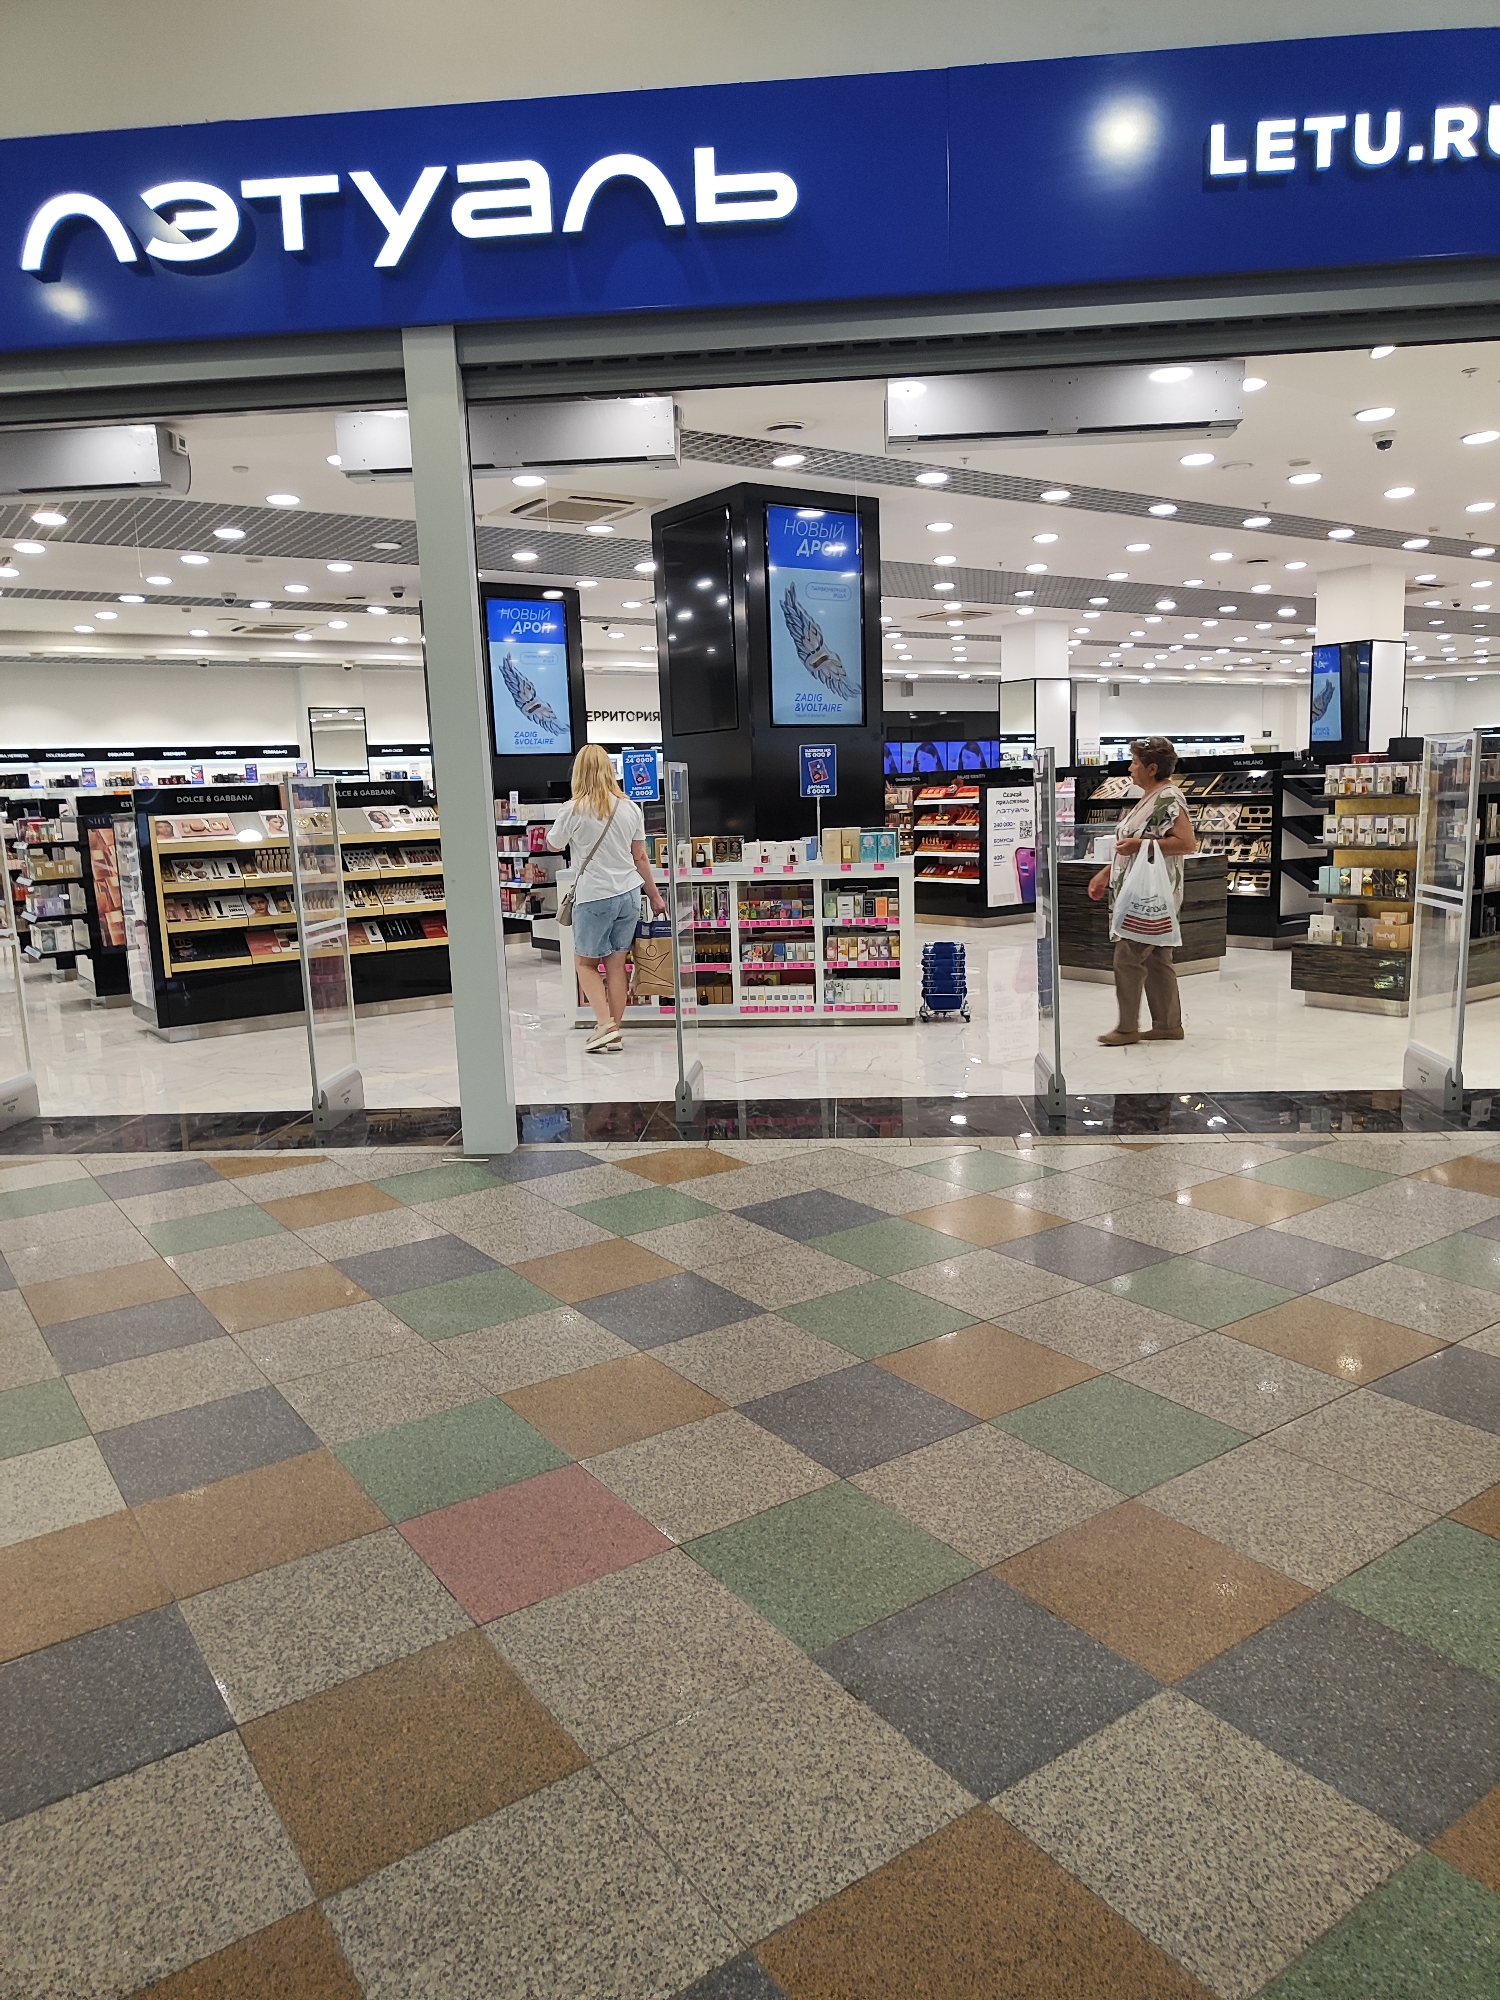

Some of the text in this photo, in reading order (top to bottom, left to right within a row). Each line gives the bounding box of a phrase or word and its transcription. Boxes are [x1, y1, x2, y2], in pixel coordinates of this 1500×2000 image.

[1208, 101, 1500, 177] LETU.R
[783, 519, 845, 540] НОВЫЙ
[796, 539, 845, 558] ДРОП
[500, 608, 551, 621] НОВЫЙ
[510, 621, 552, 635] ДРОП
[795, 693, 823, 702] ZADIG
[795, 703, 842, 712] &VOLTAIRE
[360, 788, 396, 796] GABBANA
[176, 796, 205, 804] DOLCE
[213, 794, 254, 802] GABBANA
